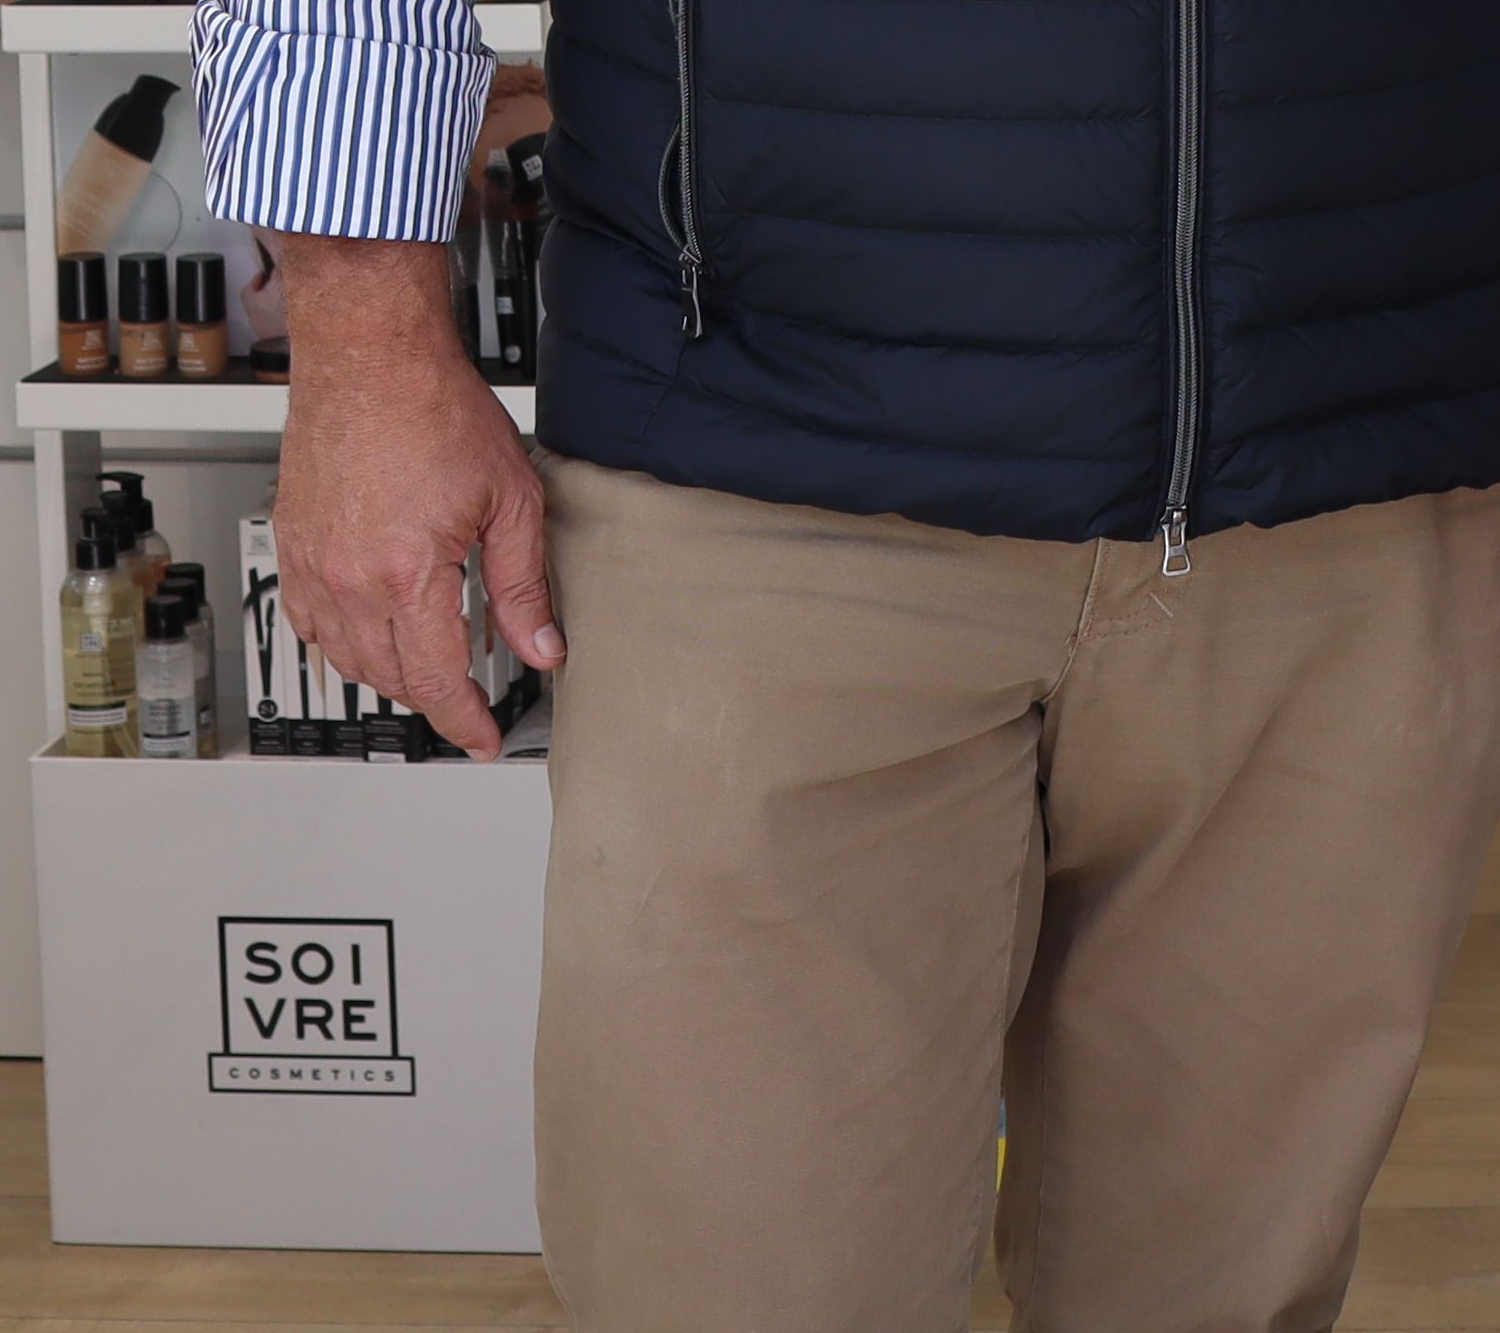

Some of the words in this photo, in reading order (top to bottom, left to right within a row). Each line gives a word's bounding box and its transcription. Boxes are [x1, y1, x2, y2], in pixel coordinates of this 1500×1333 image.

[242, 941, 362, 986] SOI
[242, 996, 379, 1041] VRE
[227, 1065, 398, 1083] COSMETICS
